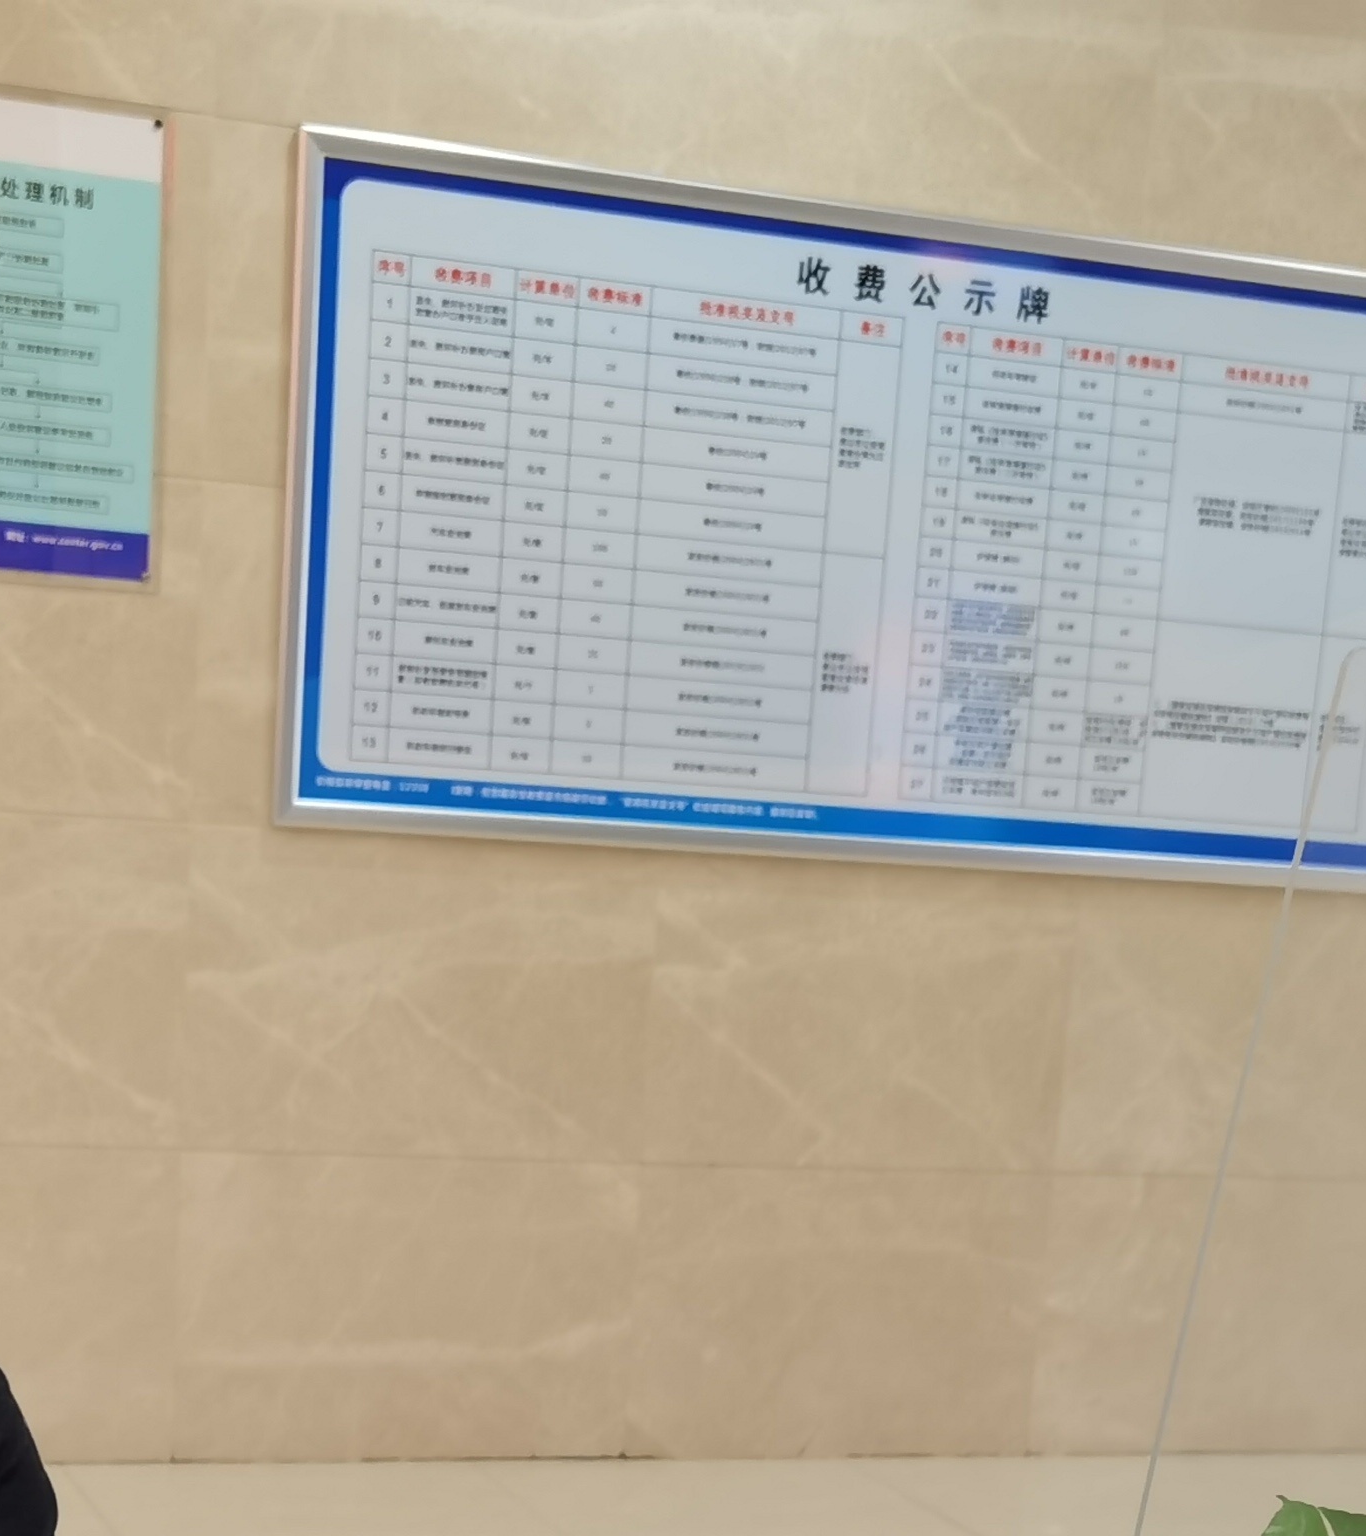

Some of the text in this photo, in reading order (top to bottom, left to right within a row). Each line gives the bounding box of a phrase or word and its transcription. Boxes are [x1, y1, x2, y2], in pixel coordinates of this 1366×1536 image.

[796, 255, 1052, 326] 收费公示牌
